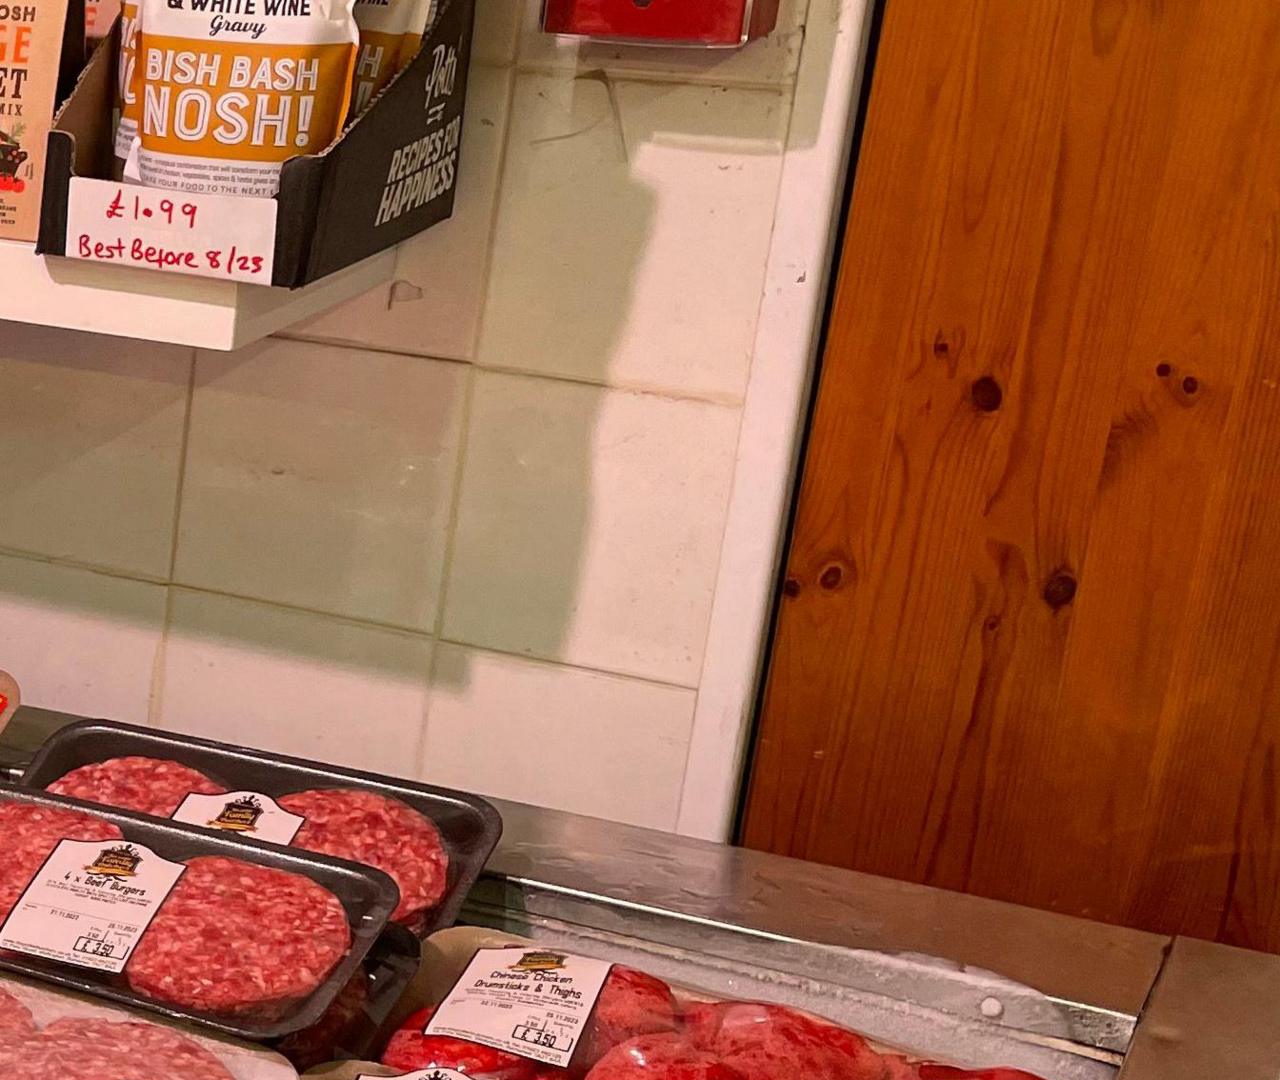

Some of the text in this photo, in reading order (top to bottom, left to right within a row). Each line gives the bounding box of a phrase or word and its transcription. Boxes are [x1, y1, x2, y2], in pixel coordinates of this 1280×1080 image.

[191, 0, 260, 15] WHITE
[264, 0, 312, 16] WINE
[209, 16, 267, 39] Gravy
[145, 48, 319, 91] BISH BASH
[143, 84, 314, 148] NOSH!
[388, 115, 460, 180] RECIPES FOR
[105, 189, 198, 229] £1.99
[374, 150, 457, 228] HAPPINESS
[79, 234, 127, 260] Best
[131, 240, 197, 271] Before
[65, 872, 71, 880] 4
[85, 875, 108, 887] Beef
[110, 882, 146, 896] Burgers
